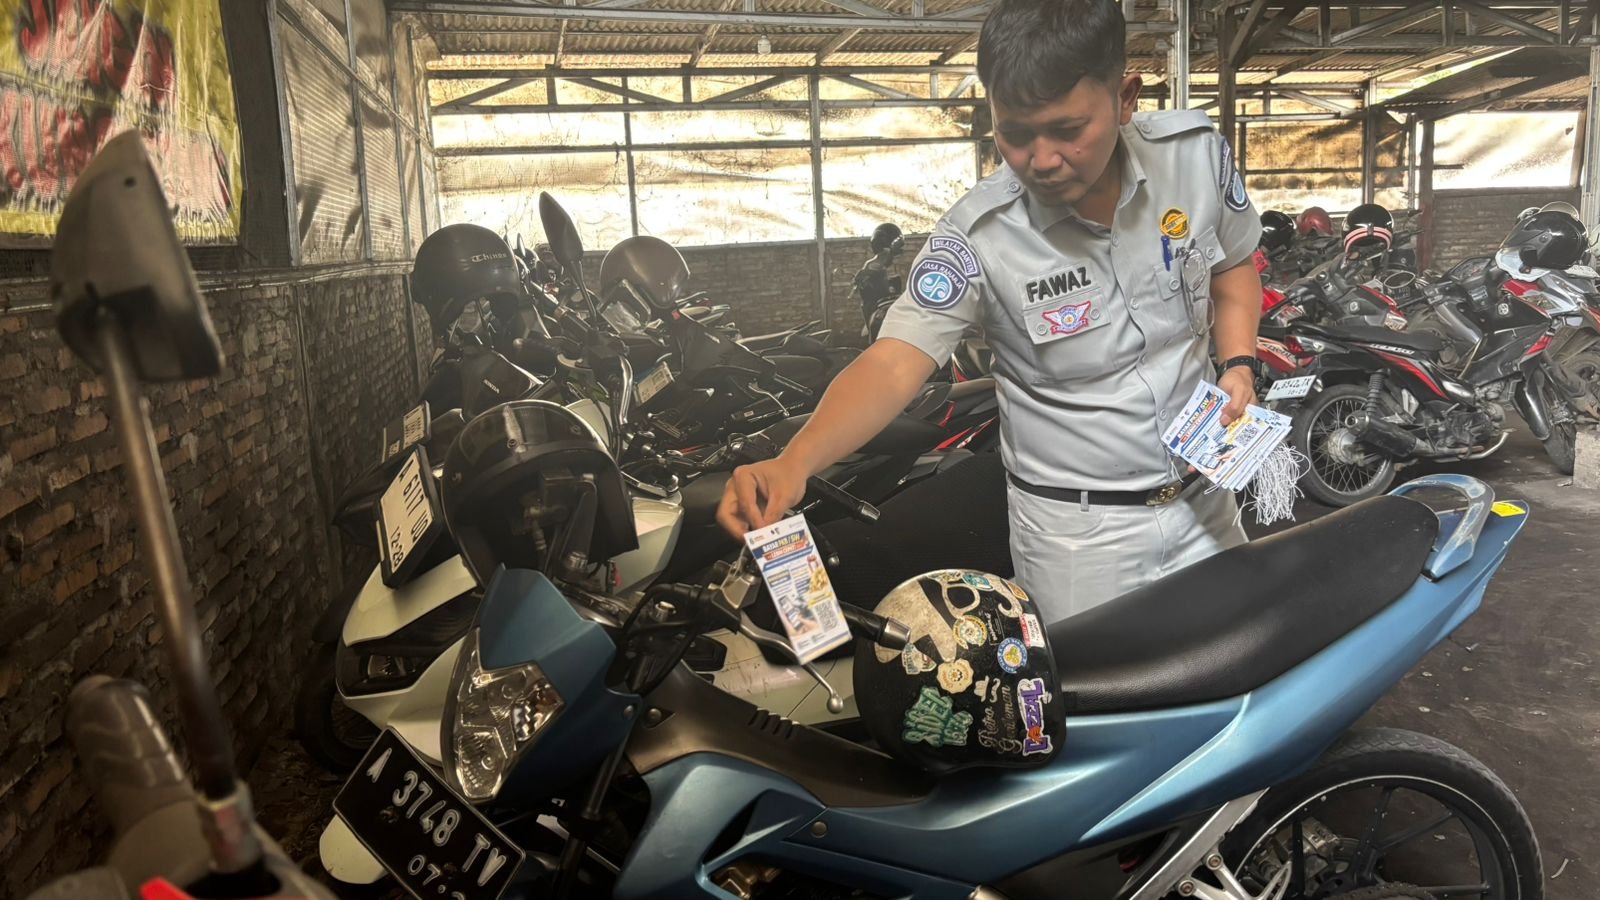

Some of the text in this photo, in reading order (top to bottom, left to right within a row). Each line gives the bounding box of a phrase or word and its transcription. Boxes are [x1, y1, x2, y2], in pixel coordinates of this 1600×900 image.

[922, 263, 938, 272] JASA
[935, 240, 974, 273] WILAYAH BANTEN
[1027, 266, 1091, 304] FAWAZ
[399, 458, 413, 481] A
[402, 472, 424, 517] 6117
[761, 541, 778, 552] BAYAR
[977, 706, 999, 749] Retro
[366, 747, 508, 887] A 3748 TV
